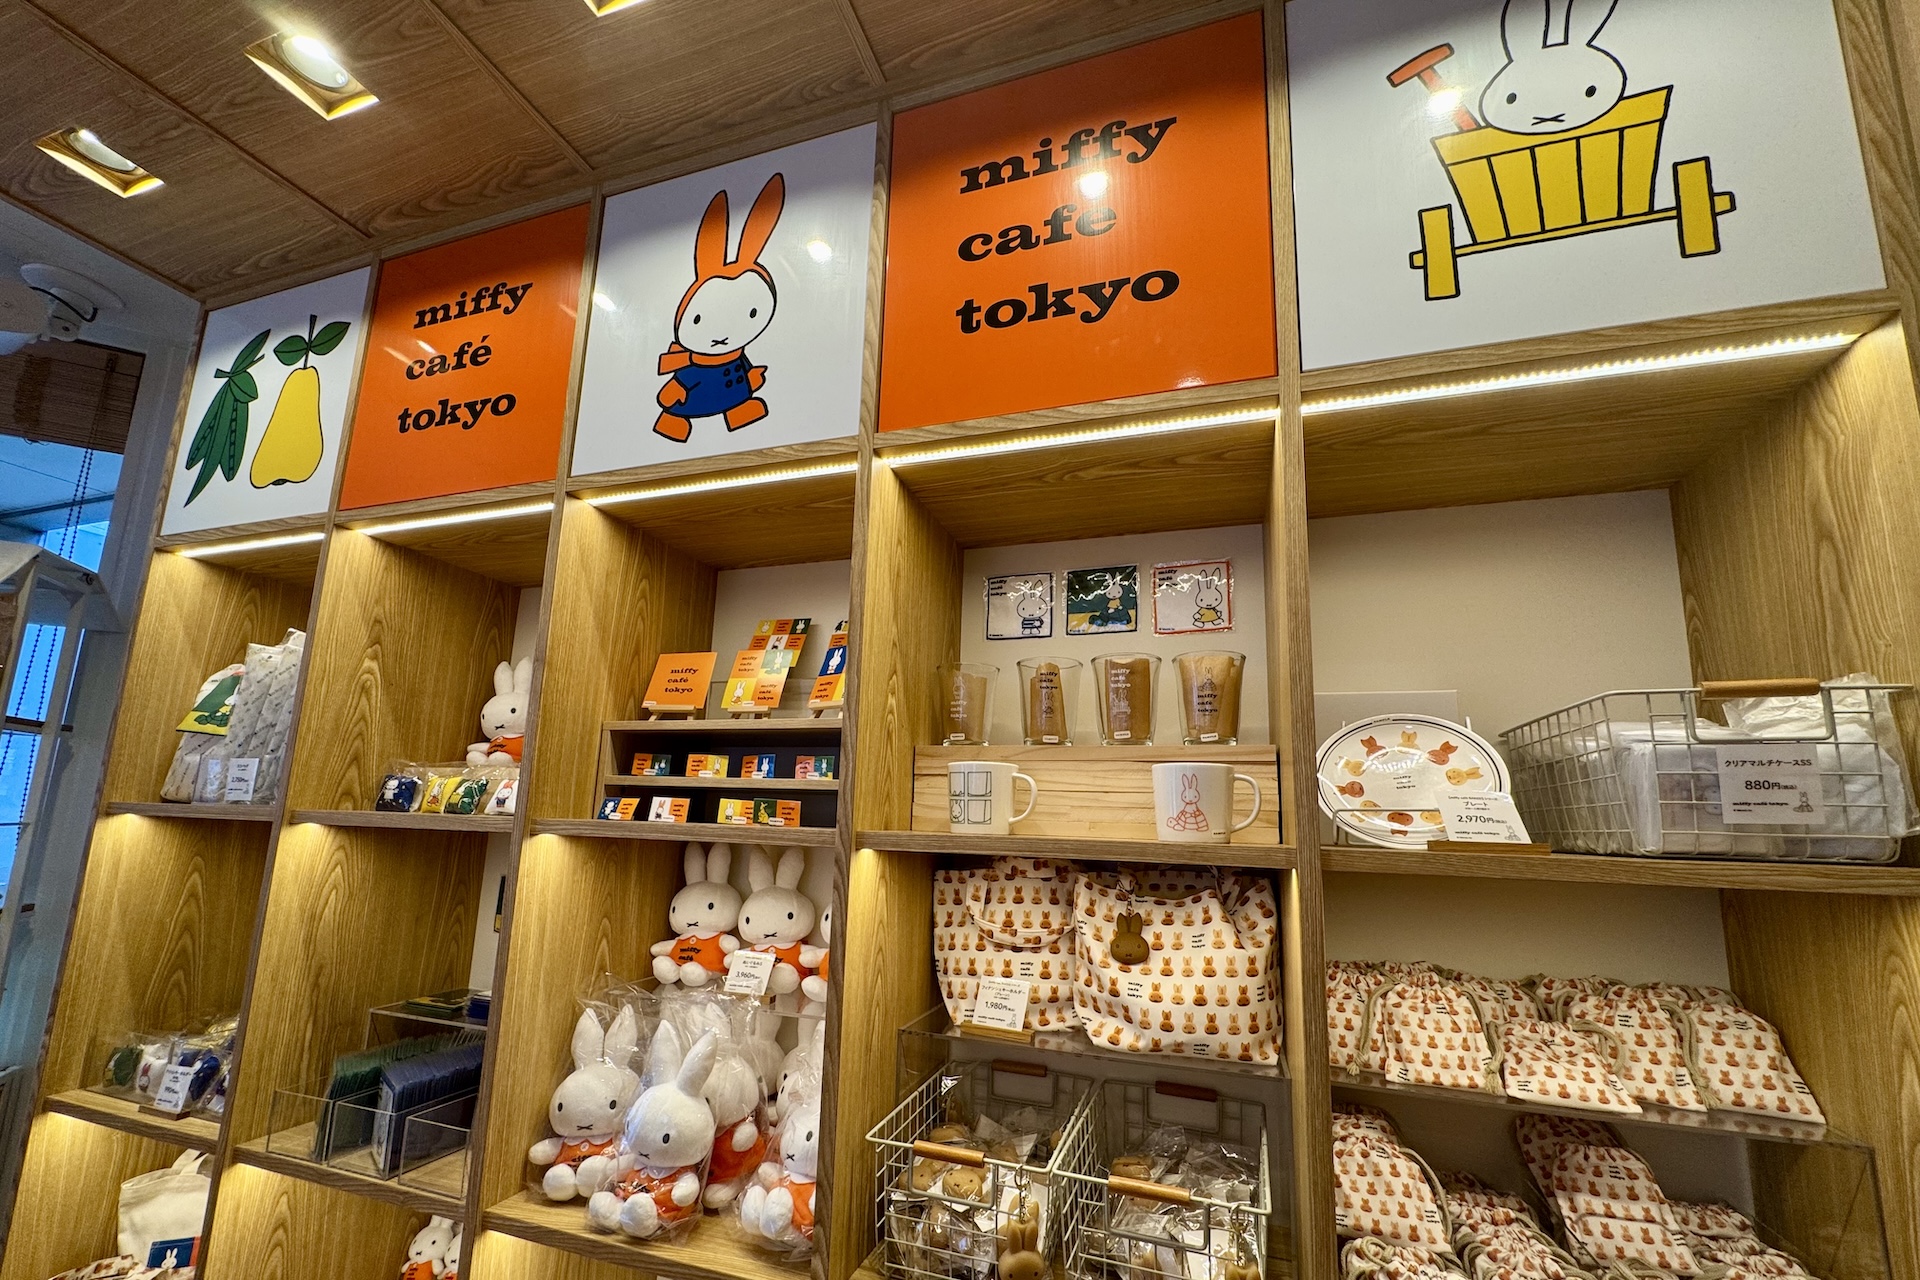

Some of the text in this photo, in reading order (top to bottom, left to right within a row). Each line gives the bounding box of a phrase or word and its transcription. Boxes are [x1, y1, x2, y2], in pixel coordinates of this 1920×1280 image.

[960, 116, 1177, 194] miffy
[413, 282, 533, 329] miffy
[956, 270, 1180, 333] tokyo
[406, 335, 492, 380] café
[398, 394, 517, 433] tokyo
[1724, 759, 1812, 767] クリアマルチケースSS
